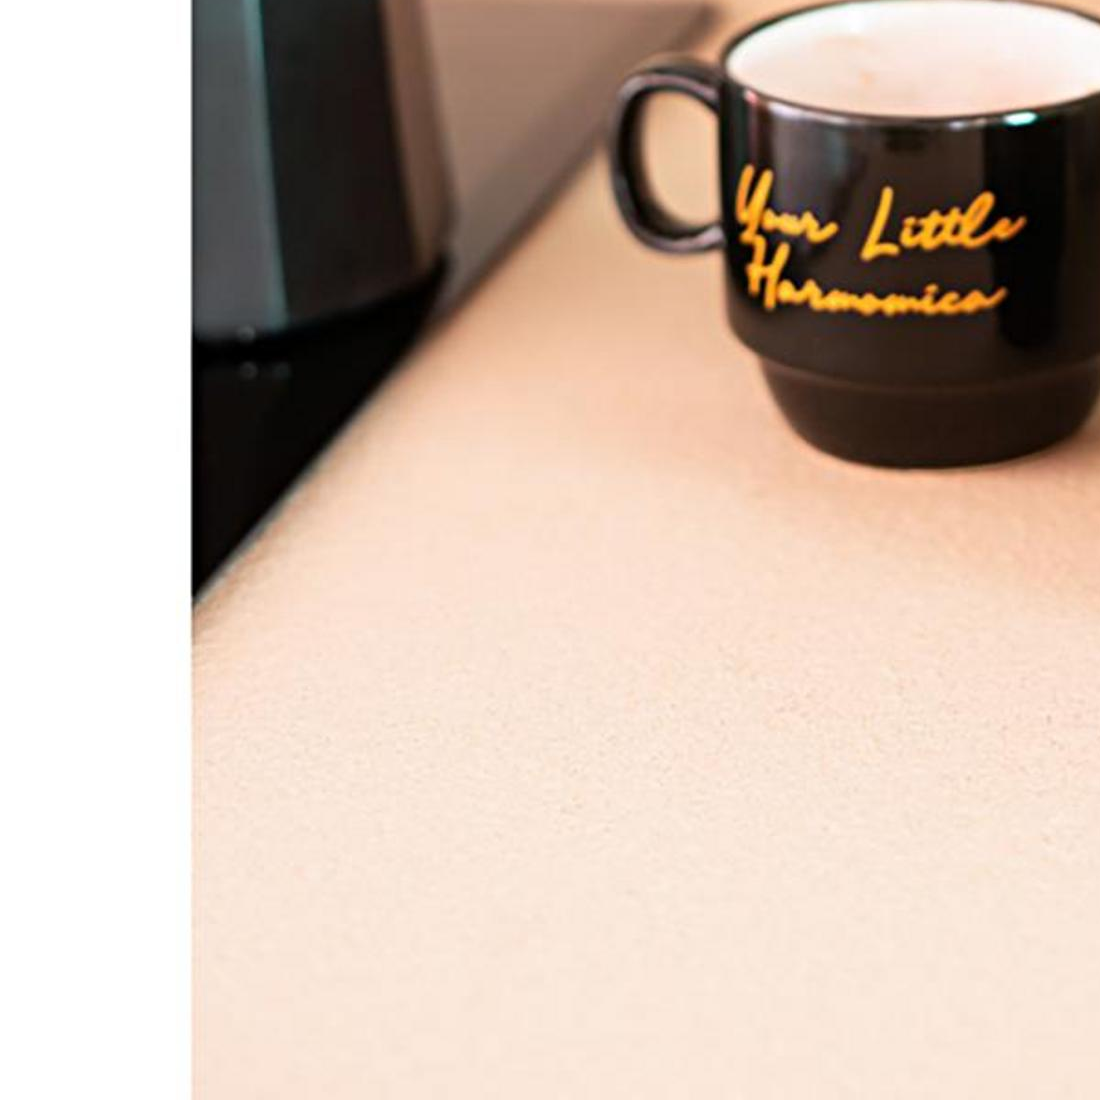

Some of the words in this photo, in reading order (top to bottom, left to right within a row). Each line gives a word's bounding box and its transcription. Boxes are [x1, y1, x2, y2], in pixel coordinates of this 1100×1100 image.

[735, 163, 839, 244] Your
[859, 186, 1027, 261] Little
[745, 234, 1009, 316] Harmonica
